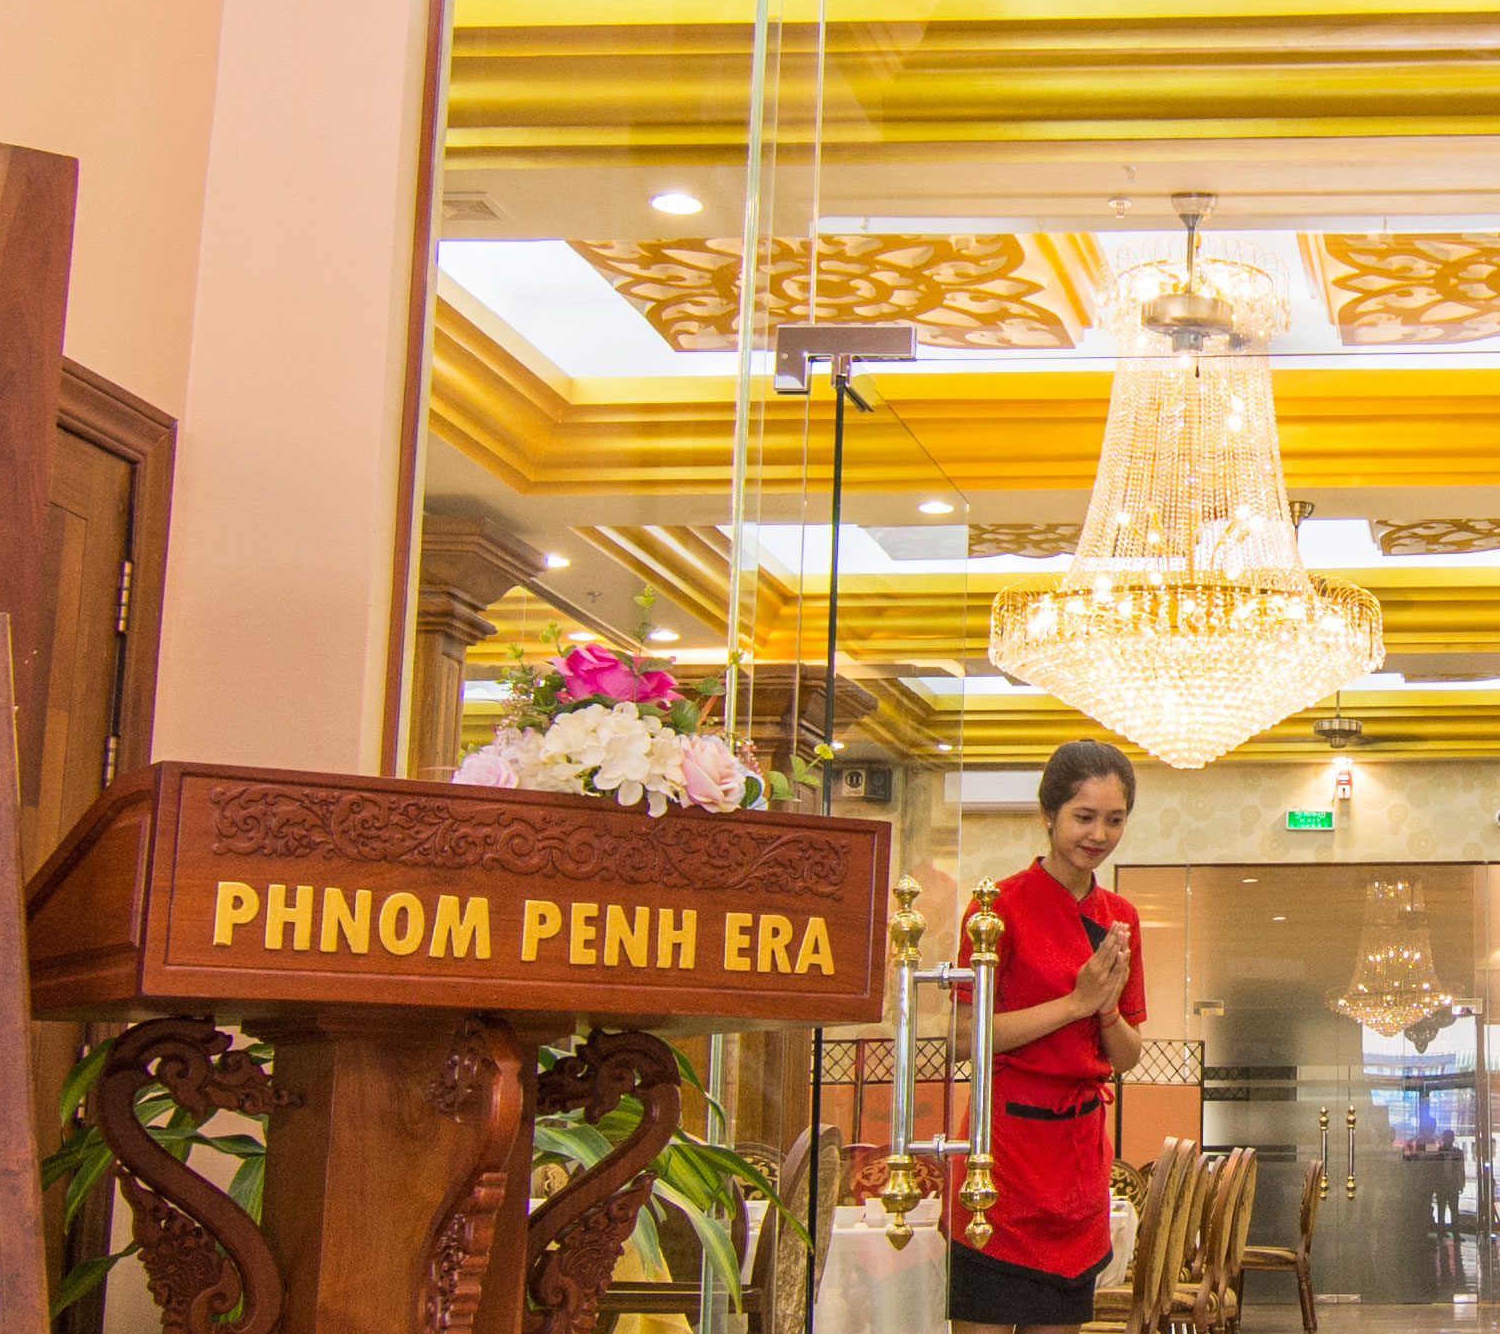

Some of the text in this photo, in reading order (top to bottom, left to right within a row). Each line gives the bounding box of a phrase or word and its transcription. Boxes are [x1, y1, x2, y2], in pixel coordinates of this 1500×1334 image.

[212, 880, 835, 976] PHNOM PENH ERA
